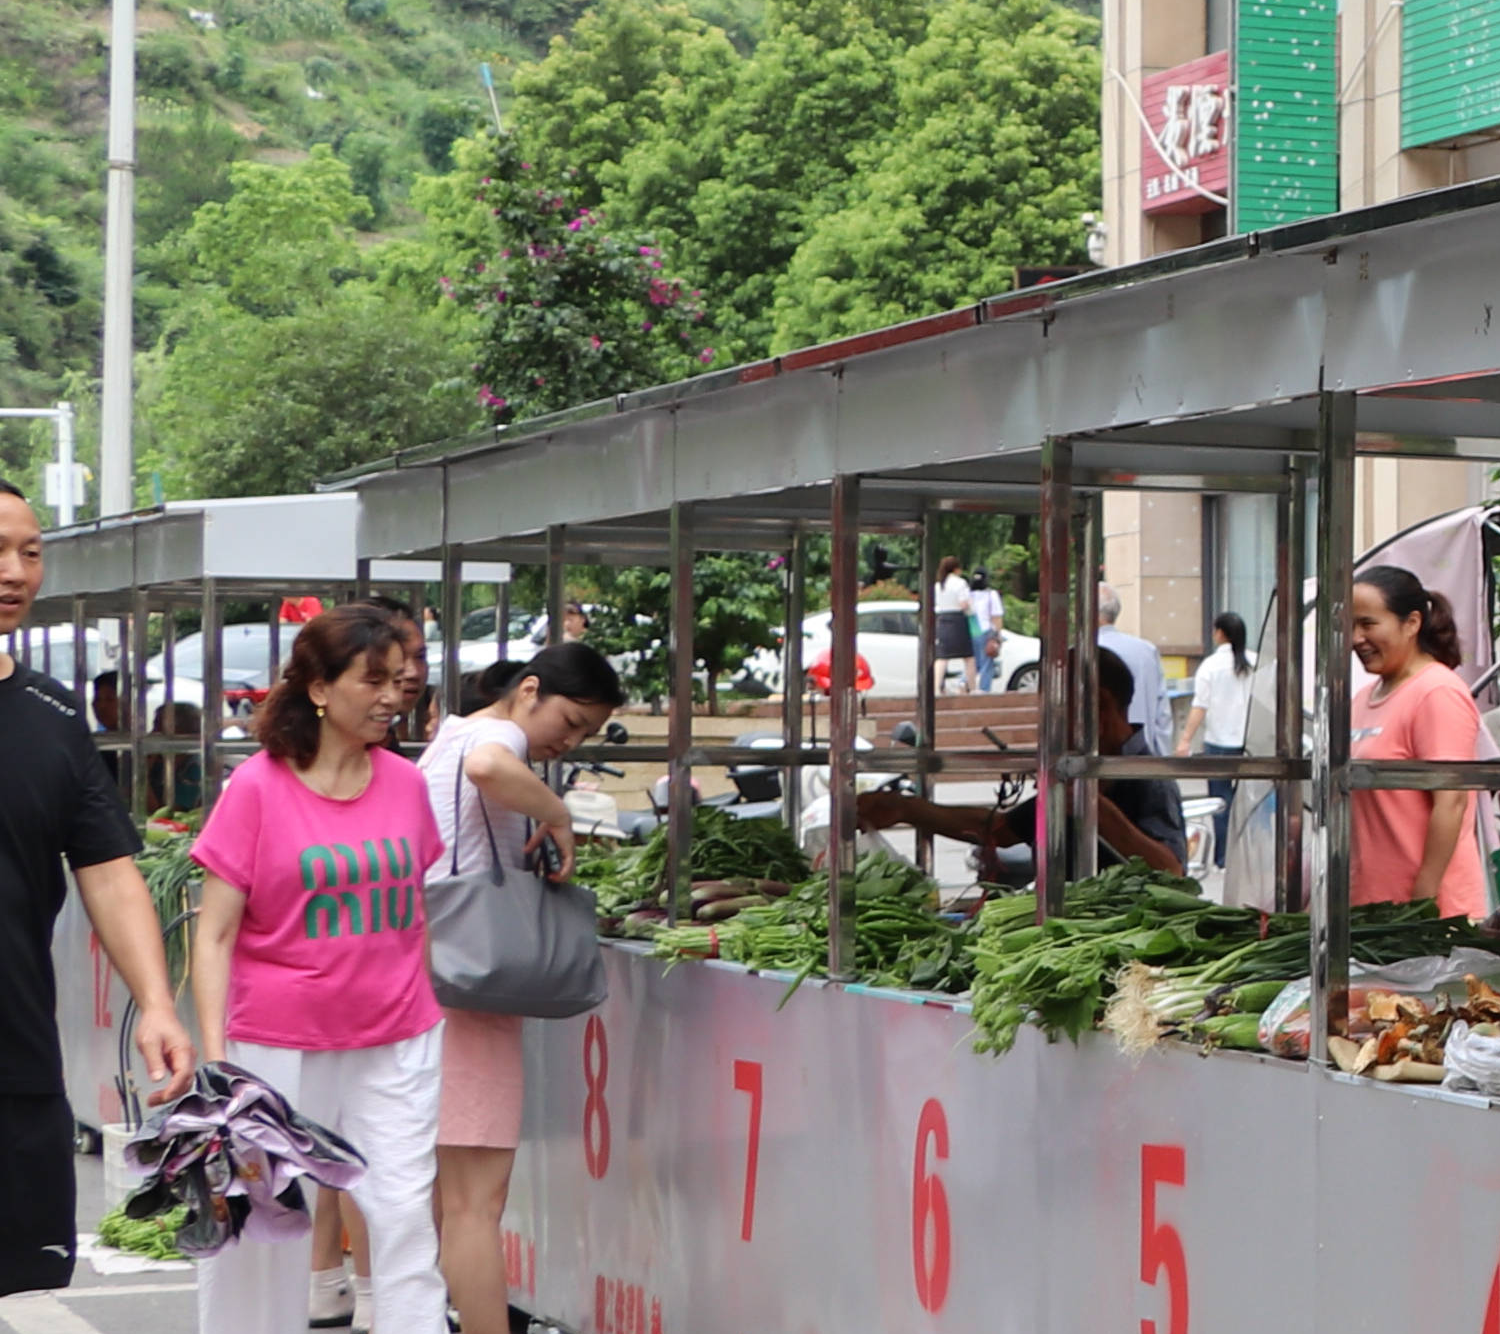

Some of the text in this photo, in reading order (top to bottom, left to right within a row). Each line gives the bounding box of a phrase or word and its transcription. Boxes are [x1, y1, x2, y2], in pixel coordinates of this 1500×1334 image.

[583, 1014, 611, 1180] 8
[734, 1059, 763, 1242] 7
[912, 1097, 951, 1315] 6
